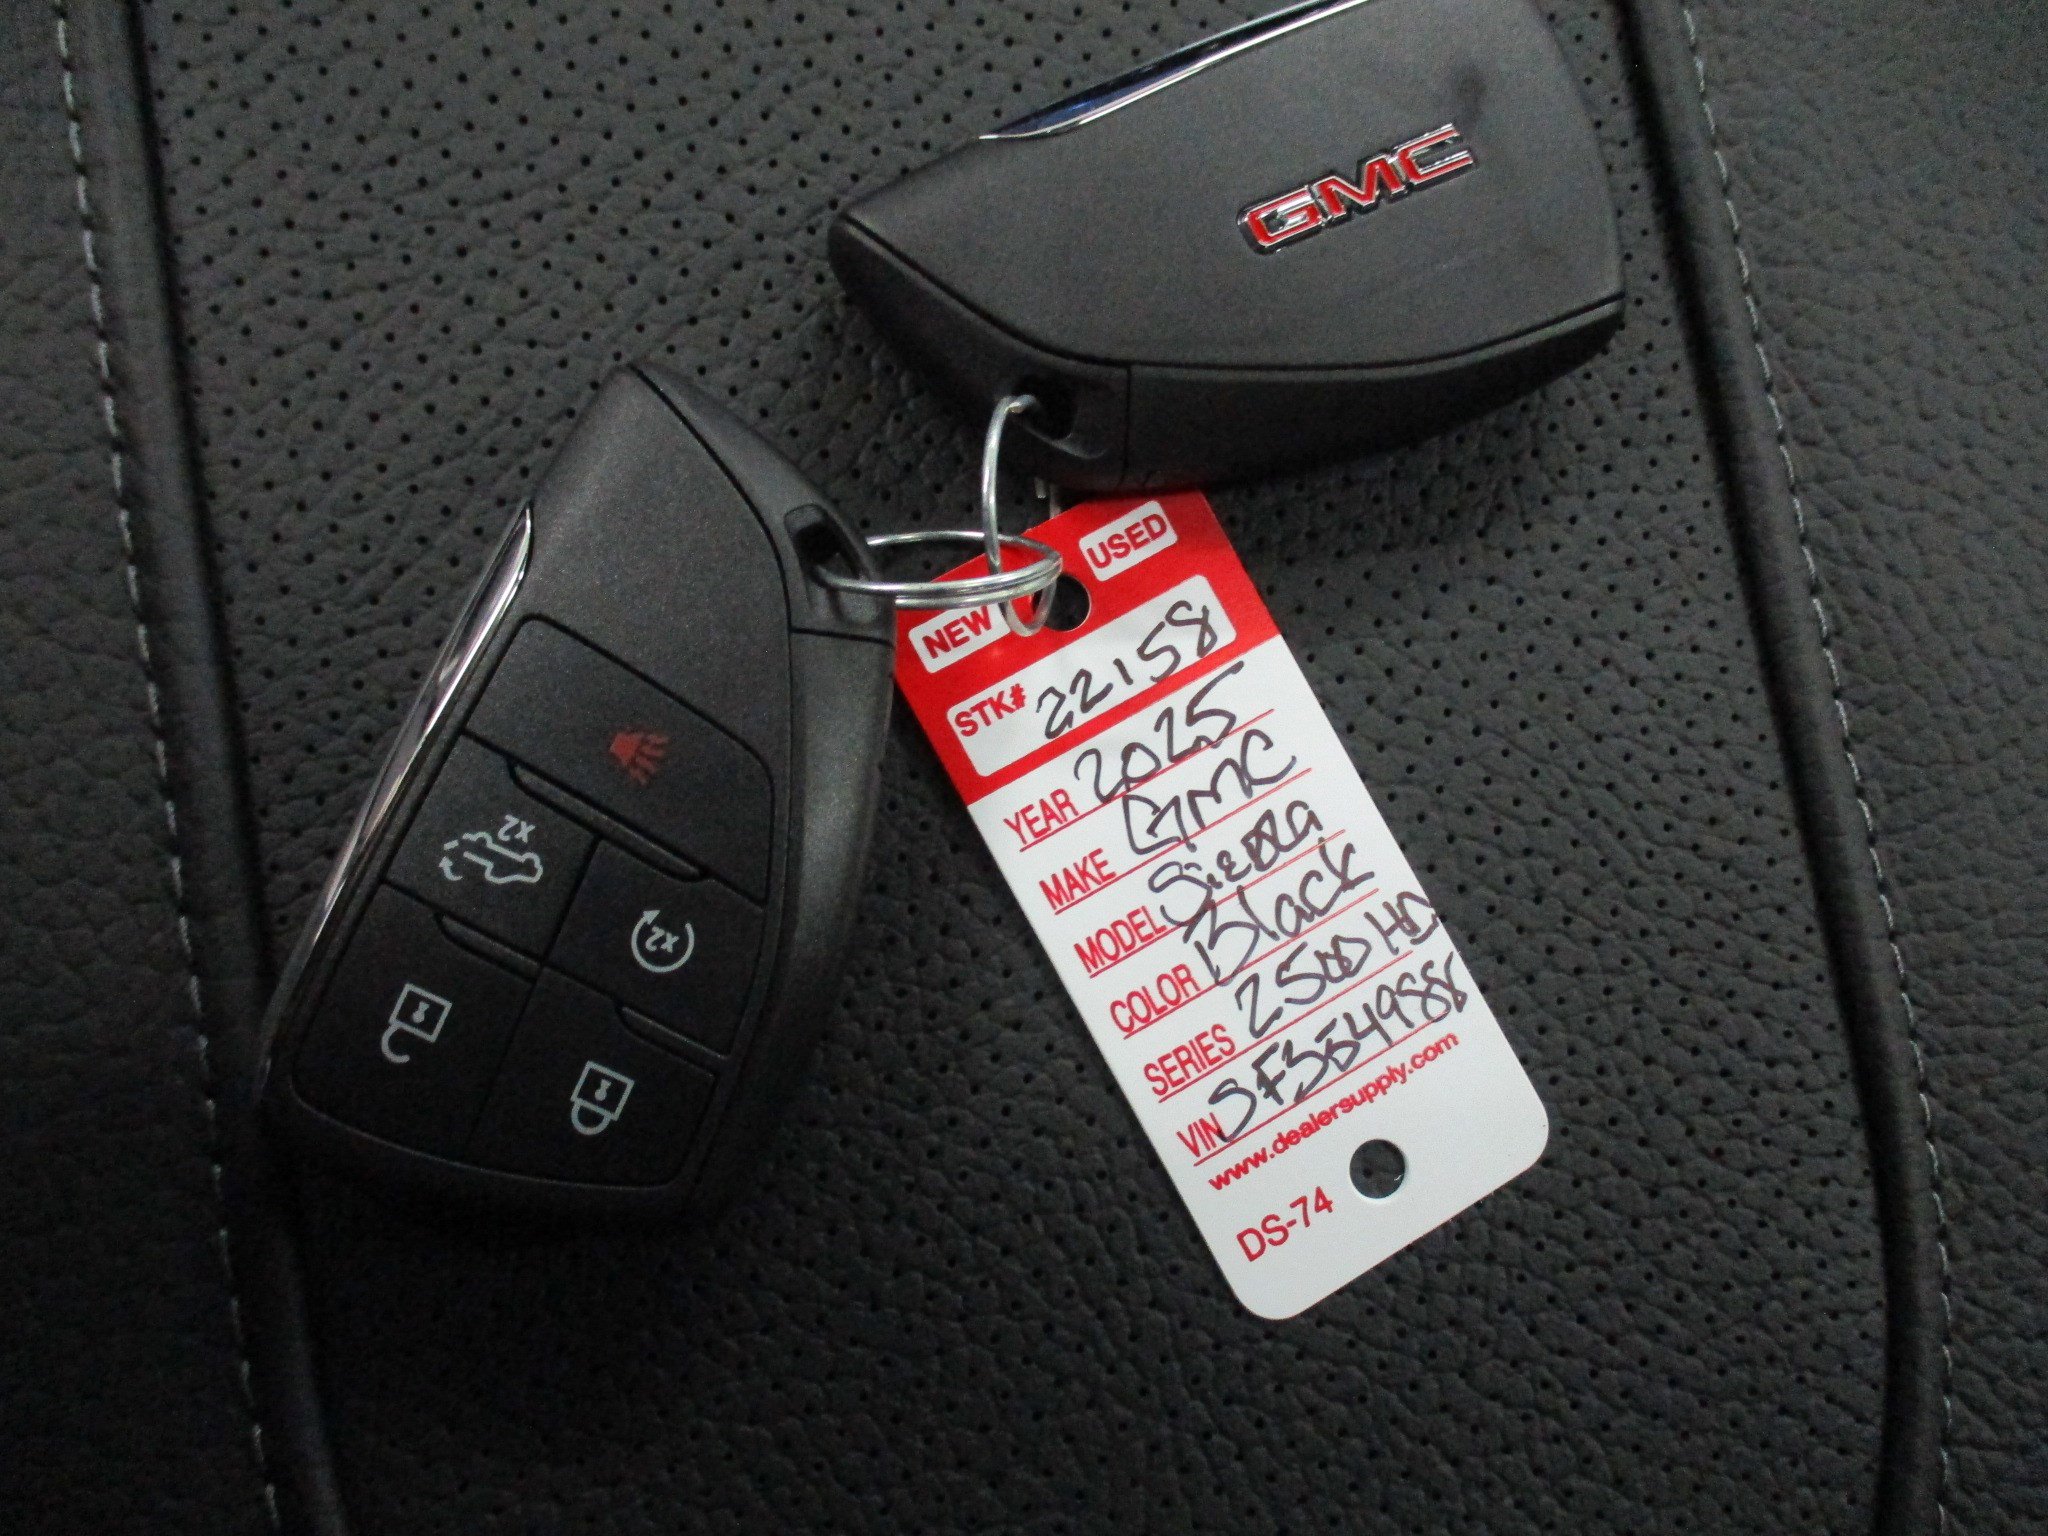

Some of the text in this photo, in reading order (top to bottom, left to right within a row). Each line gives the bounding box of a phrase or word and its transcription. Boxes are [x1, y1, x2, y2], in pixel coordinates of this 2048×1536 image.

[1237, 123, 1477, 253] GMC
[1086, 513, 1168, 570] USED
[921, 608, 994, 660] NEW
[1036, 600, 1219, 740] 22158
[954, 682, 1028, 738] STK#
[1073, 660, 1245, 804] 2025
[1003, 788, 1079, 845] YEAR
[1038, 848, 1118, 911] MAKE
[1182, 837, 1375, 986] Black
[1073, 905, 1168, 975] MODEL
[1109, 963, 1201, 1035] COLOR
[1143, 1023, 1237, 1097] SERIES
[1176, 1112, 1227, 1160] VIN
[1208, 1031, 1460, 1191] www.dealersupply.com
[1236, 1185, 1334, 1263] DS-74
